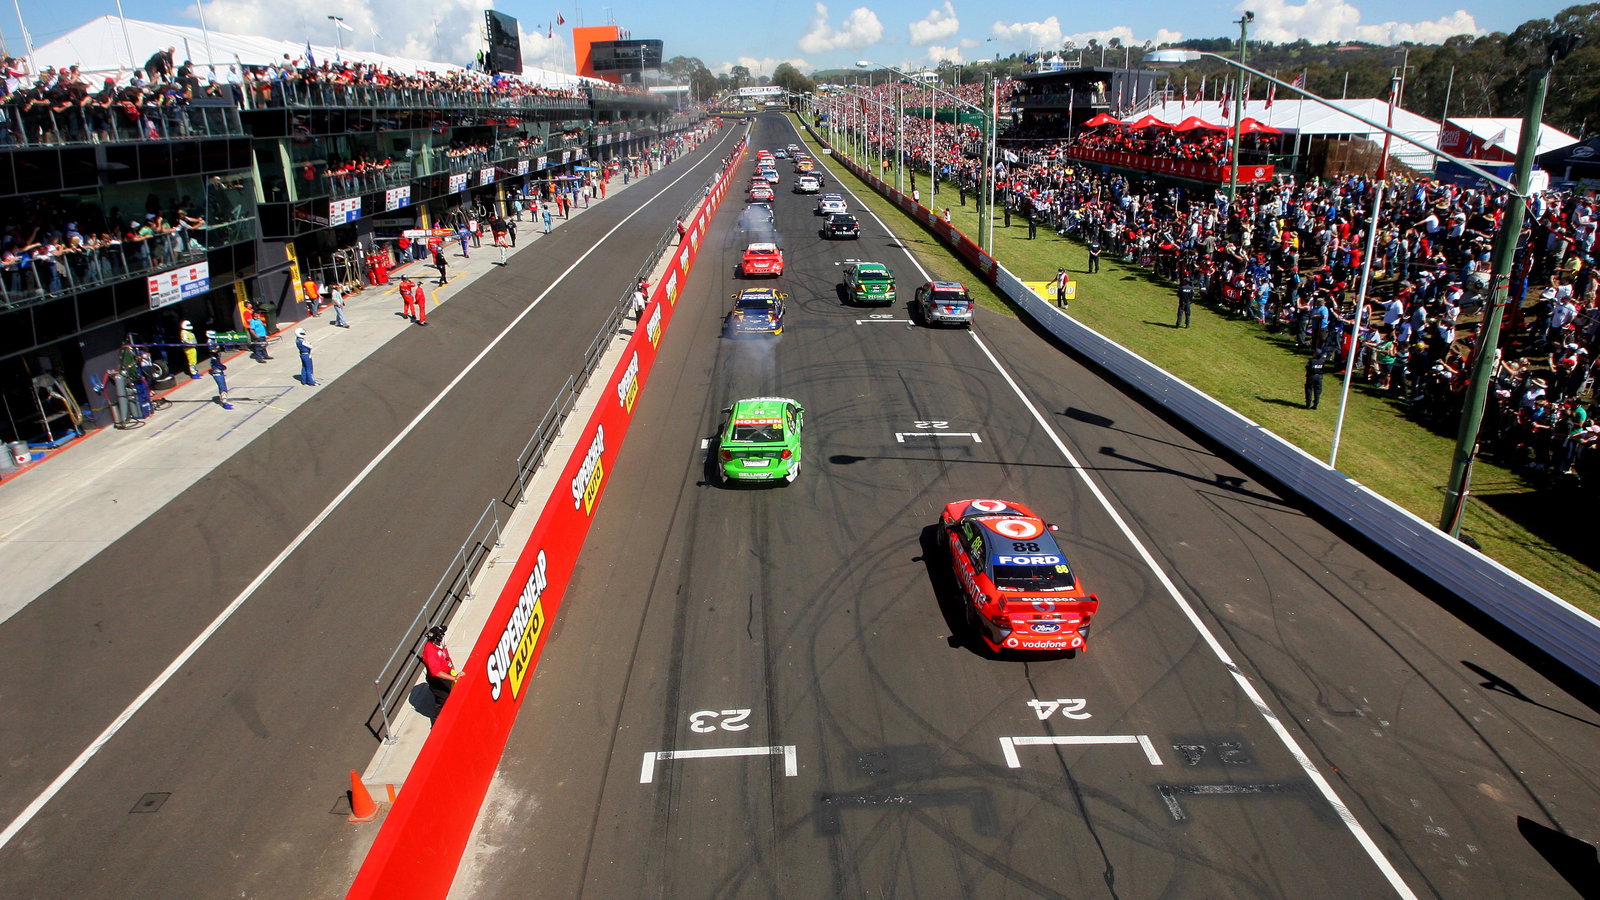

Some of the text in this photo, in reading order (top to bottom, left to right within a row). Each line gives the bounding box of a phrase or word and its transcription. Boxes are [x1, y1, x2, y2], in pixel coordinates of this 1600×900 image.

[914, 420, 949, 429] 22
[572, 424, 605, 510] SUPERCHEAP
[587, 467, 601, 506] AUTO
[1012, 542, 1040, 552] 88
[999, 556, 1060, 565] FORD
[1055, 565, 1069, 574] 88
[486, 549, 548, 701] SUPERCHEAP
[1035, 624, 1056, 632] Ford
[514, 612, 540, 680] AUTO
[1026, 698, 1093, 720] 24
[689, 708, 751, 733] 23
